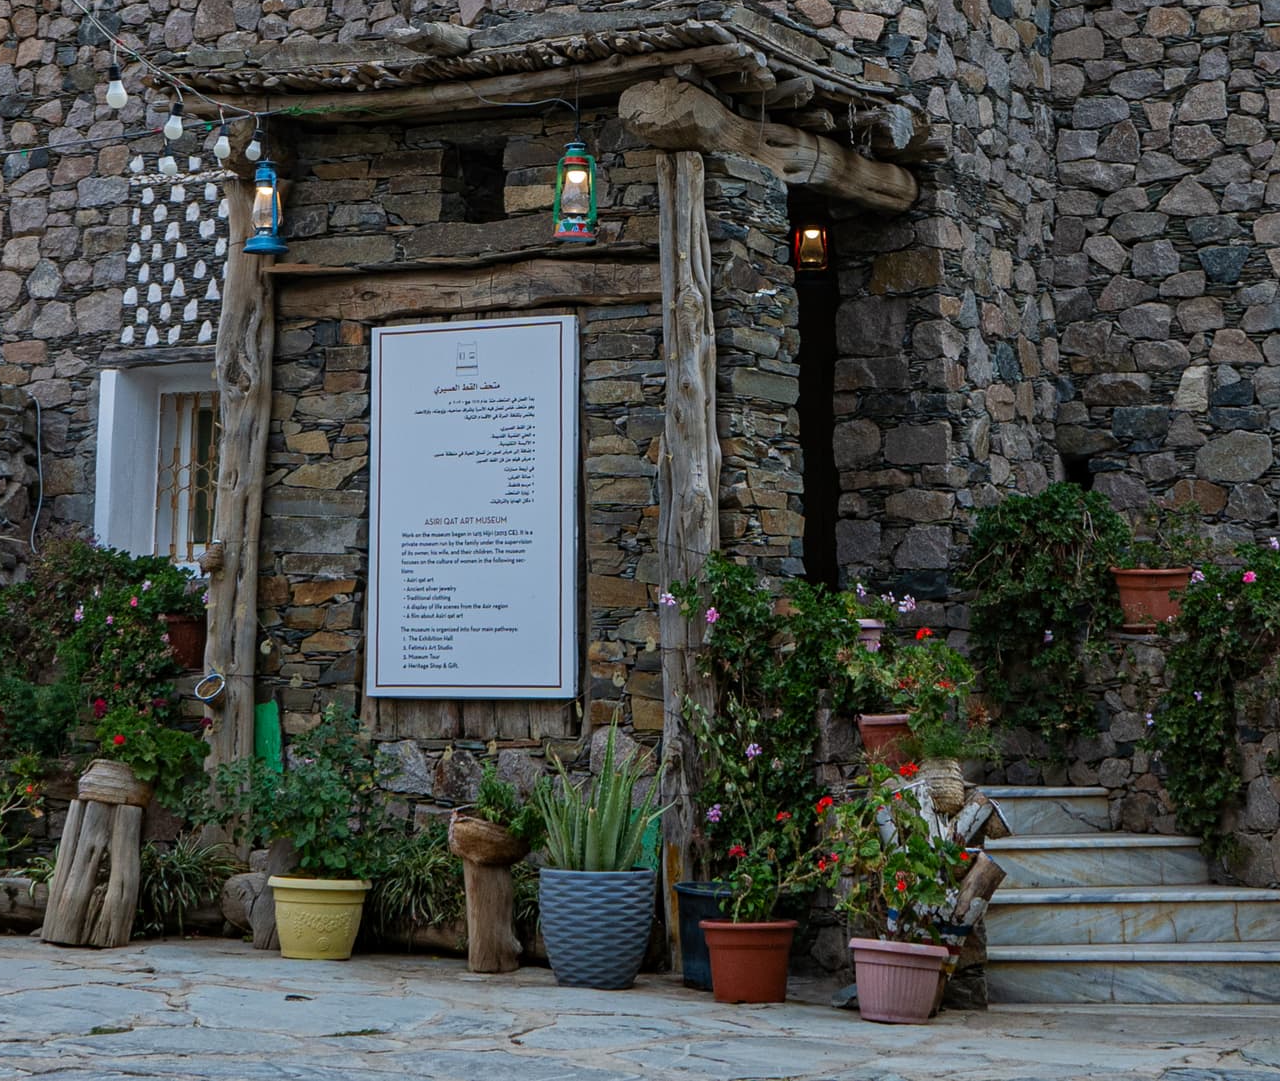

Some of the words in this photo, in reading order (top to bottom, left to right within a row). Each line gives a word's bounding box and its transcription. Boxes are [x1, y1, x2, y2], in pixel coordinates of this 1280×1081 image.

[433, 384, 460, 395] العسيري
[444, 517, 458, 525] QAT
[475, 516, 508, 524] MUSEUM
